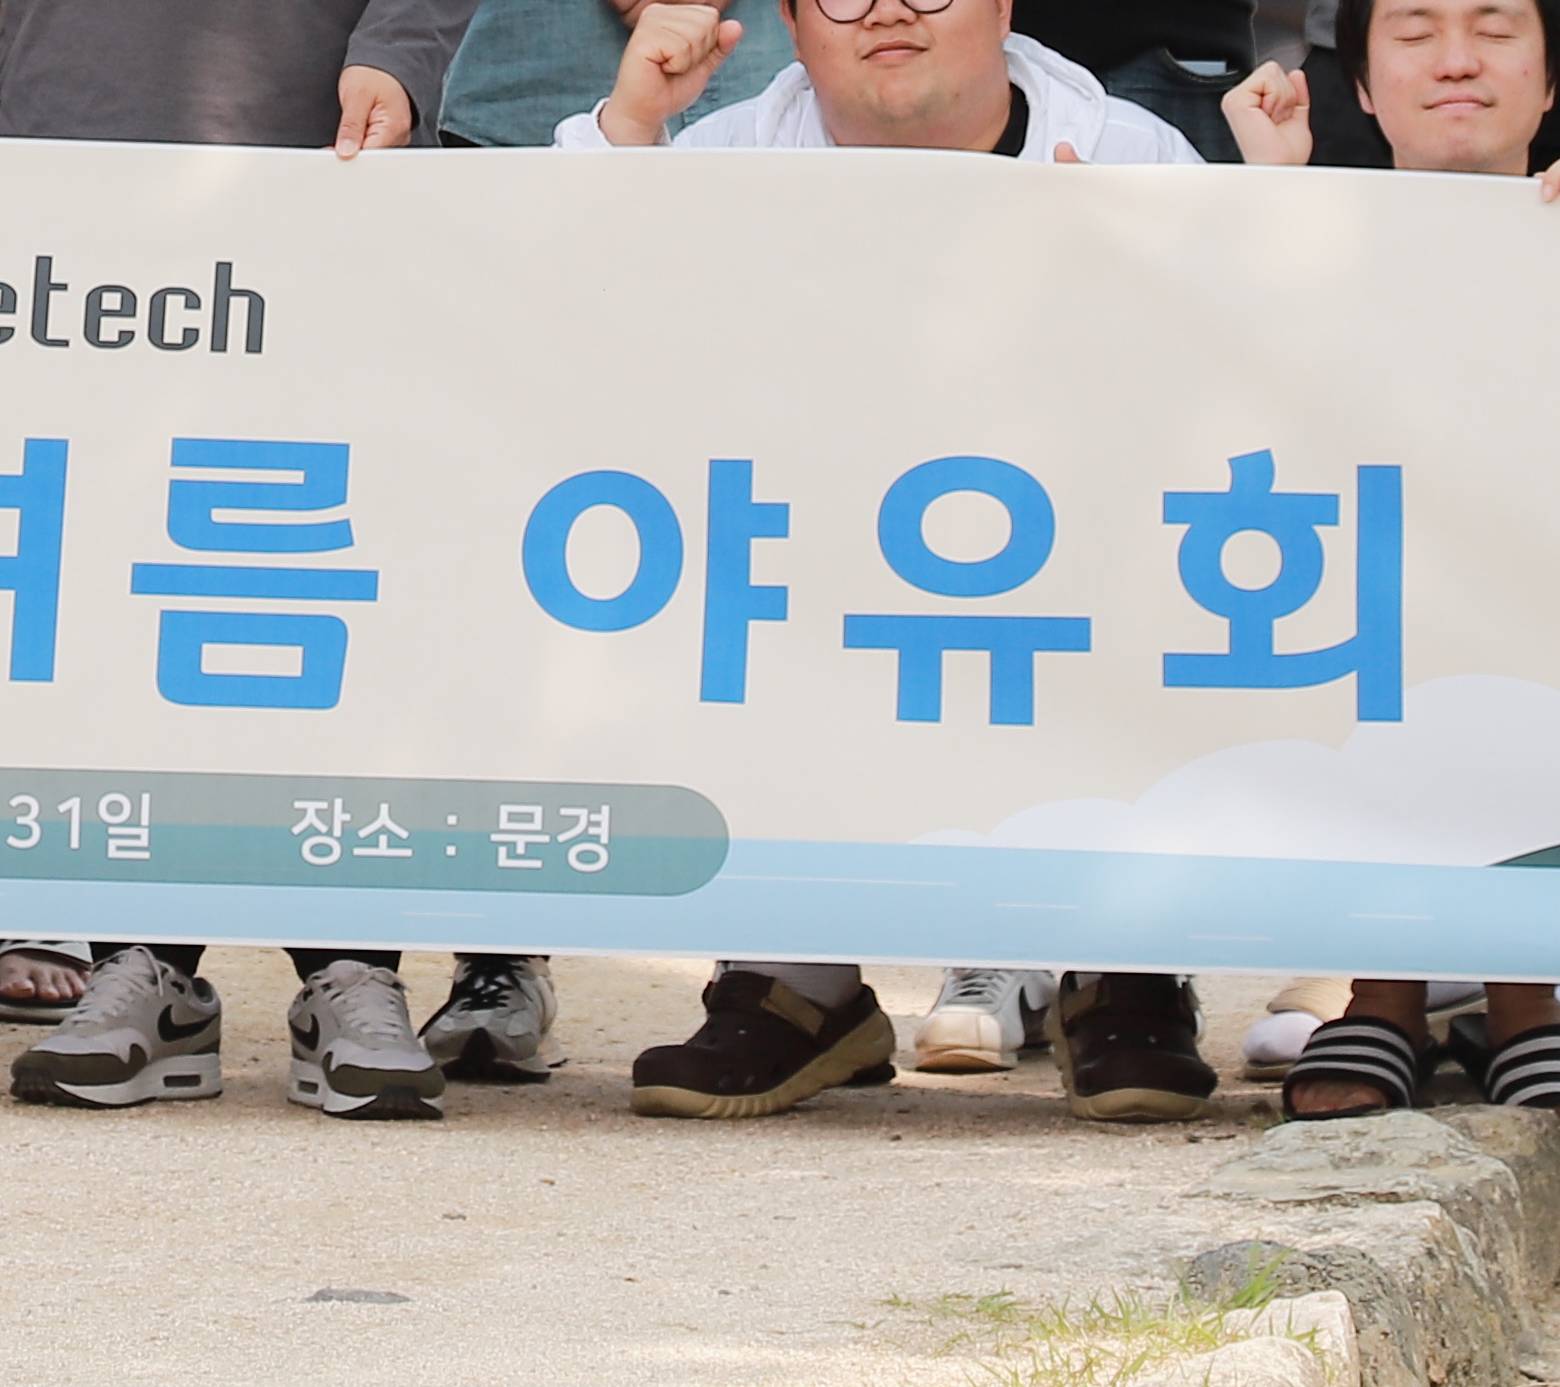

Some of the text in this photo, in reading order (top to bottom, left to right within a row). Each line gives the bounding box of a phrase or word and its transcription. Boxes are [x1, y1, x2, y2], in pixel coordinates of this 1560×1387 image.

[522, 449, 1406, 727] 야유회
[5, 791, 151, 860] 31일
[290, 797, 414, 866] 장소
[489, 803, 612, 873] 문경
